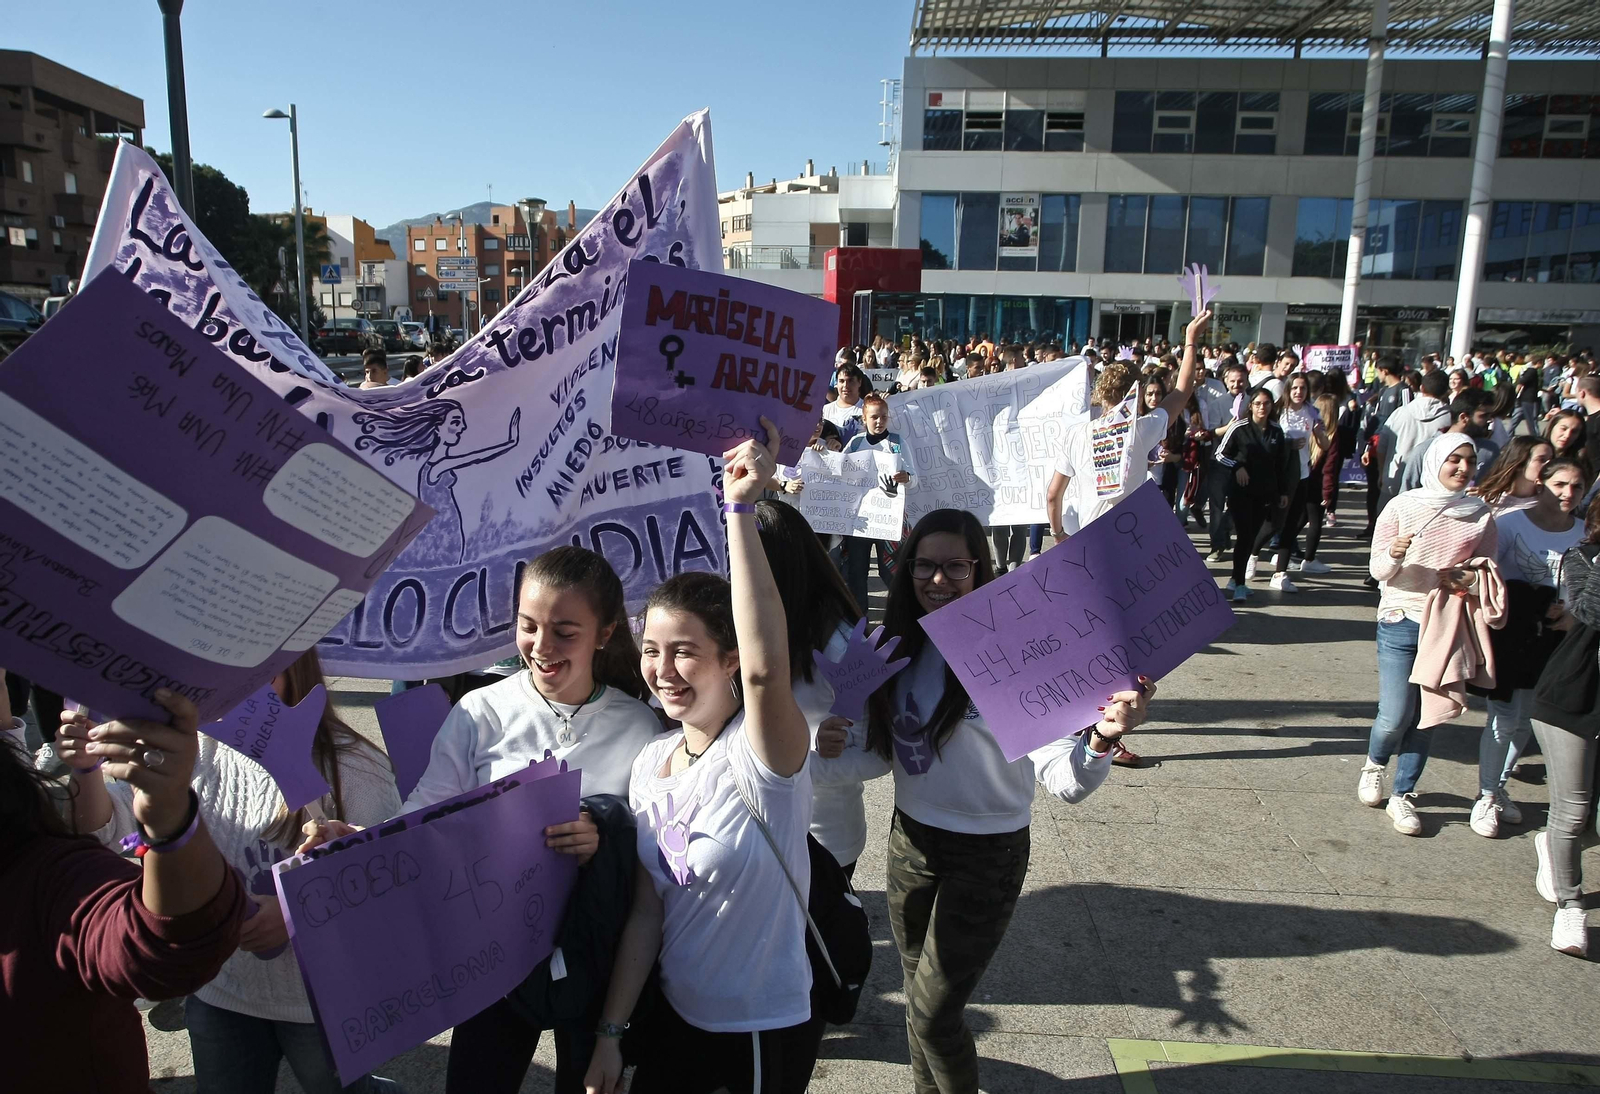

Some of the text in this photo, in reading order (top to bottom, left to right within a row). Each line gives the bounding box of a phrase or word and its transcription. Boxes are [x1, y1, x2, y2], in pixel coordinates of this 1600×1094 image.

[128, 173, 204, 272] La
[645, 284, 796, 359] MARISELA
[211, 372, 253, 421] UNA
[549, 333, 619, 409] VIOLEN
[711, 352, 817, 413] ARAUZ
[177, 411, 226, 457] UNA
[624, 392, 660, 426] 48
[514, 387, 588, 499] INSULTOS
[546, 419, 604, 513] MIEDO
[973, 419, 1067, 468] MUJER
[579, 455, 687, 509] MUERTE
[951, 488, 993, 510] SER
[961, 642, 1020, 687] 44
[1065, 607, 1107, 641] LA
[1104, 540, 1194, 613] LAGUNA
[836, 663, 889, 694] VIOLENCIA
[233, 728, 247, 749] NO
[243, 698, 261, 715] LA
[247, 691, 282, 760] VIOLENCIA
[559, 732, 572, 744] M
[296, 850, 422, 929] ROSA
[442, 854, 504, 921] 45
[340, 939, 507, 1055] BARCELONA
